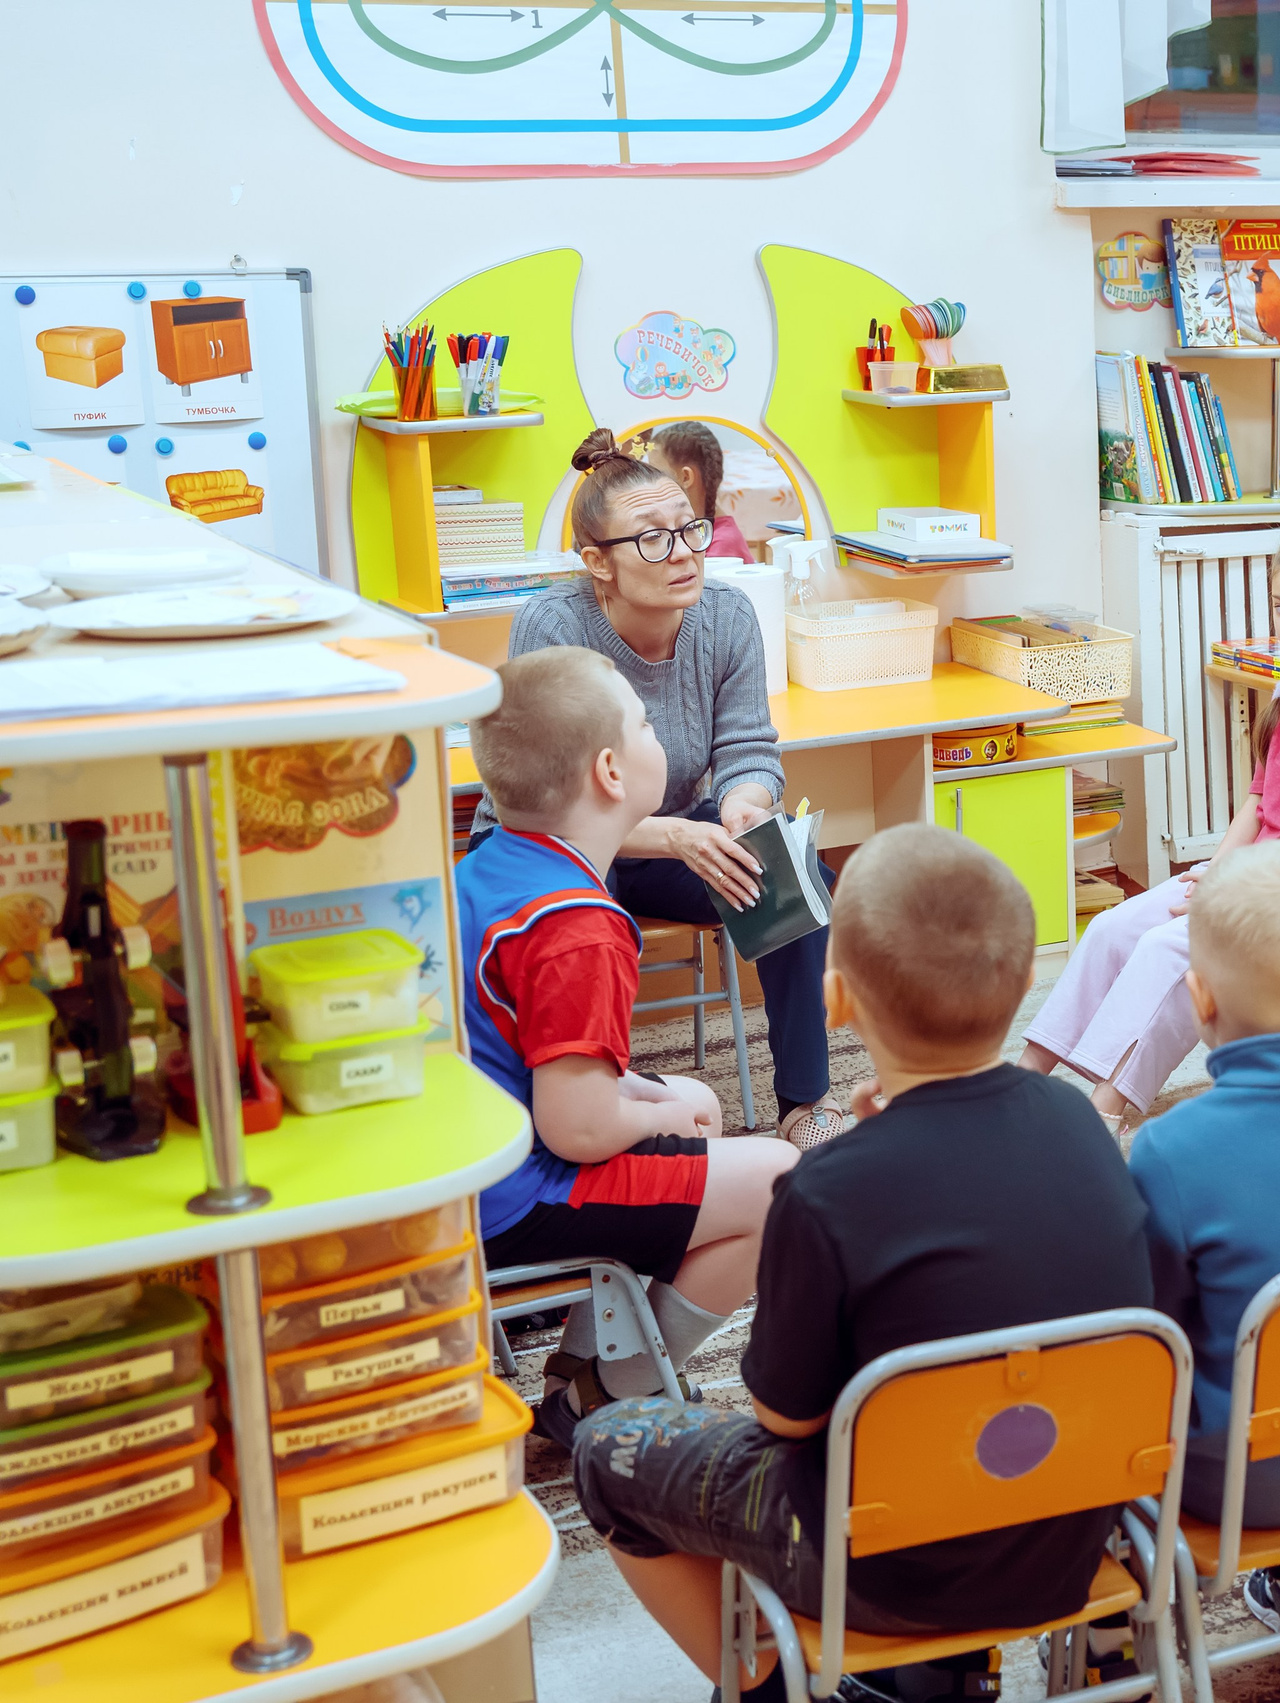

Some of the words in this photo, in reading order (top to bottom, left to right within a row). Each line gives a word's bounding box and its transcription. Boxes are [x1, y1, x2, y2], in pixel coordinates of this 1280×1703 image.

[1106, 282, 1169, 302] БИБЛИОТЕК
[637, 329, 715, 387] РЕЧЕВИЧОК
[73, 412, 107, 421] ПУФИК
[186, 406, 236, 416] ТУМБОЧКА
[929, 523, 968, 533] ТОМИК
[268, 902, 366, 931] Воздух
[324, 1301, 381, 1322] Перья
[332, 1353, 415, 1382] Ракушки
[50, 1370, 131, 1397] Желуди
[286, 1420, 370, 1448] Морские
[376, 1390, 469, 1426] обитатели
[0, 1442, 101, 1472] аждачная
[108, 1419, 178, 1450] бумага
[0, 1507, 95, 1540] оллекция
[102, 1479, 181, 1514] листьев
[312, 1495, 415, 1530] Коллекция
[422, 1470, 498, 1505] ракушек
[117, 1561, 189, 1599] камней
